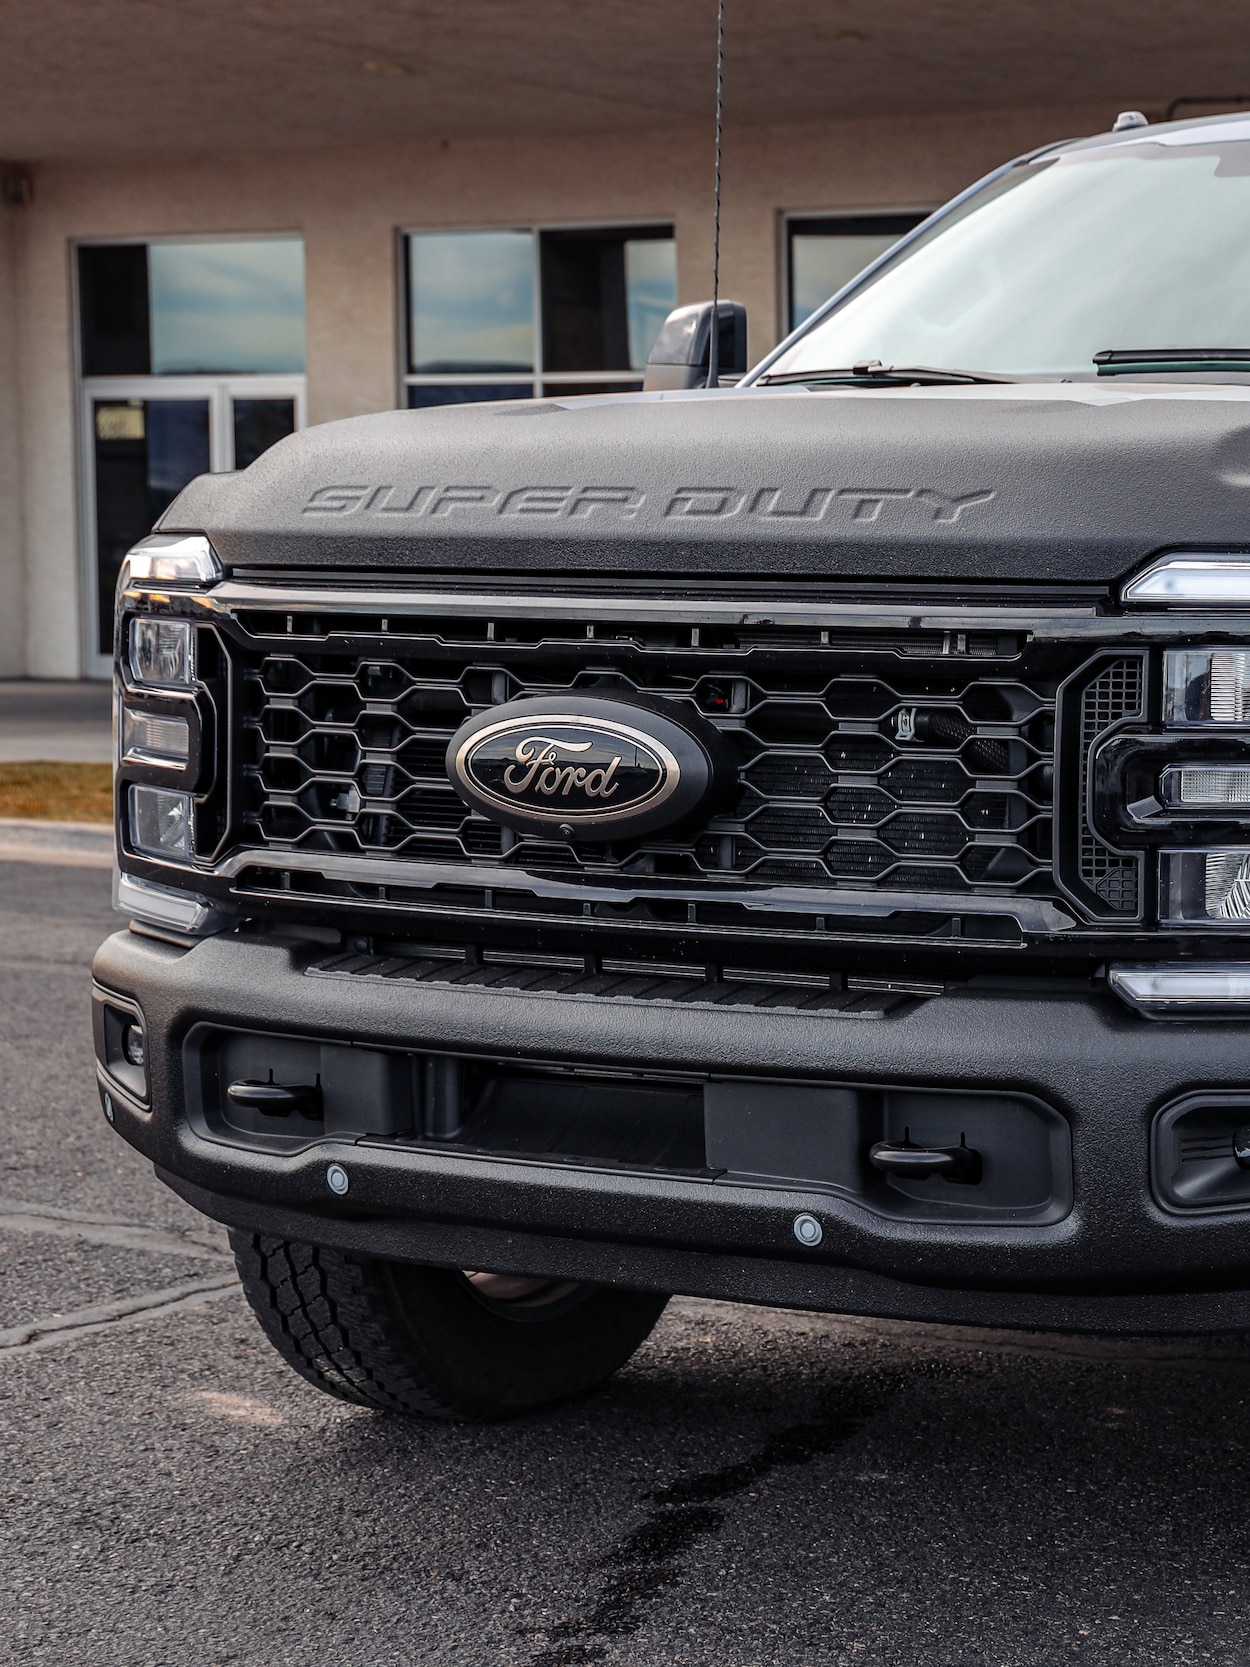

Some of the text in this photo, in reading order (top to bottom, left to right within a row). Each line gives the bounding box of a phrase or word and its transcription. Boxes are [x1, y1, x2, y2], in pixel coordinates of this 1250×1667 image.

[302, 484, 996, 523] SUPER DUTY
[503, 735, 623, 798] Ford
